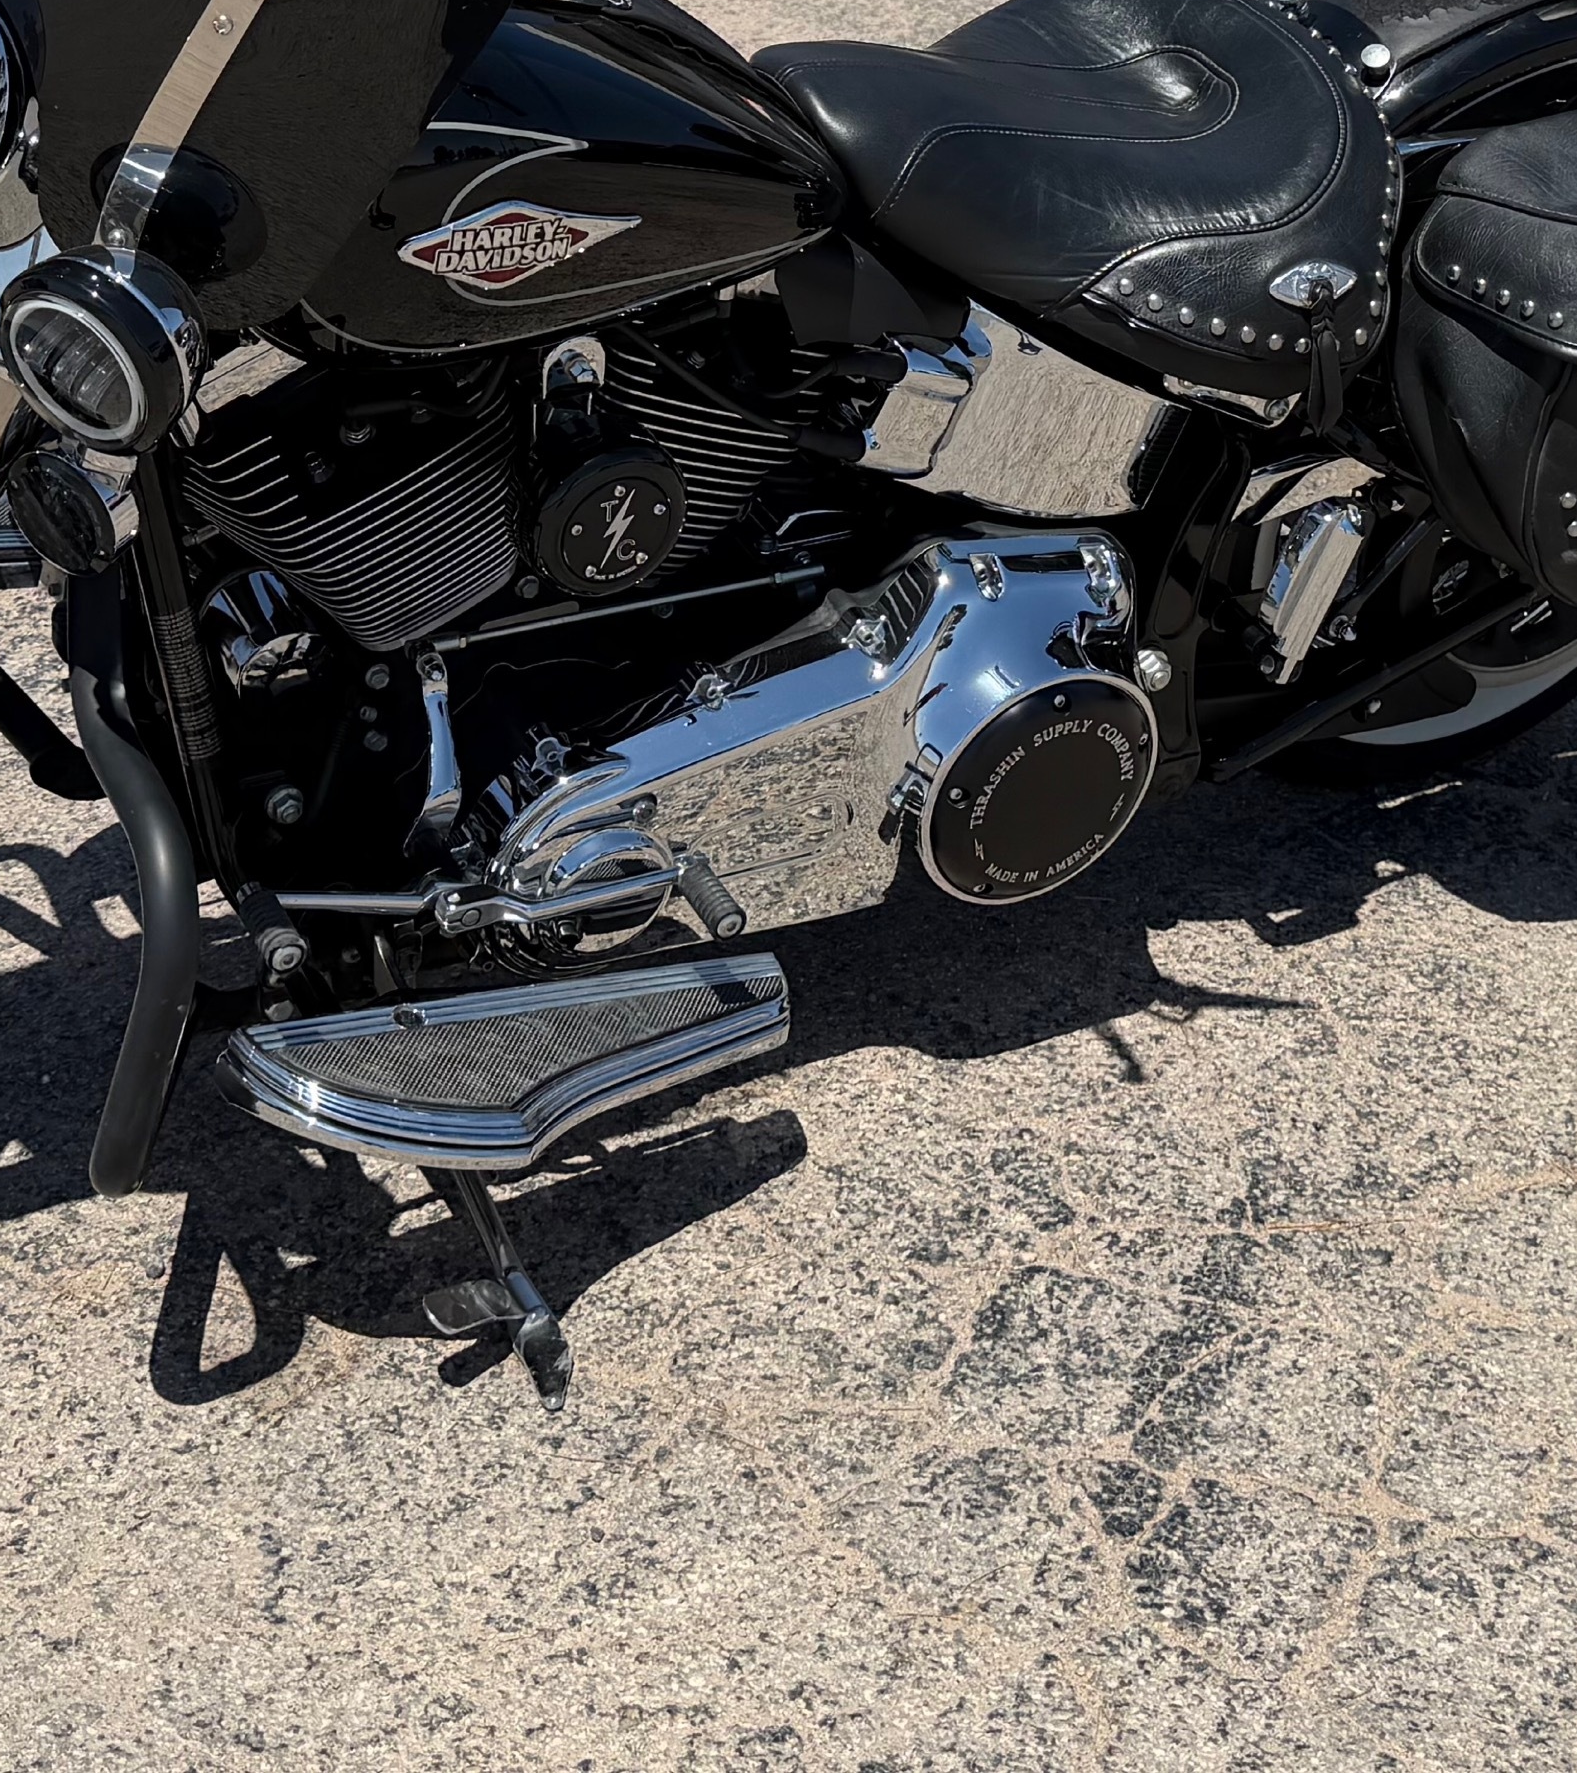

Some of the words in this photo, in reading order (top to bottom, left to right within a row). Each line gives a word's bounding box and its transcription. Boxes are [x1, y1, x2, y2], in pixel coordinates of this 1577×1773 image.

[450, 218, 567, 252] HARLEY-
[435, 237, 571, 274] DAVIDSON
[600, 500, 619, 522] T
[616, 539, 636, 561] C
[969, 745, 1027, 830] THRASHIN
[1033, 719, 1093, 748] SUPPLY
[1096, 723, 1135, 782] COMPANY
[984, 862, 1020, 884] MADE
[1024, 870, 1039, 883] IN
[1045, 832, 1105, 879] AMERICA
